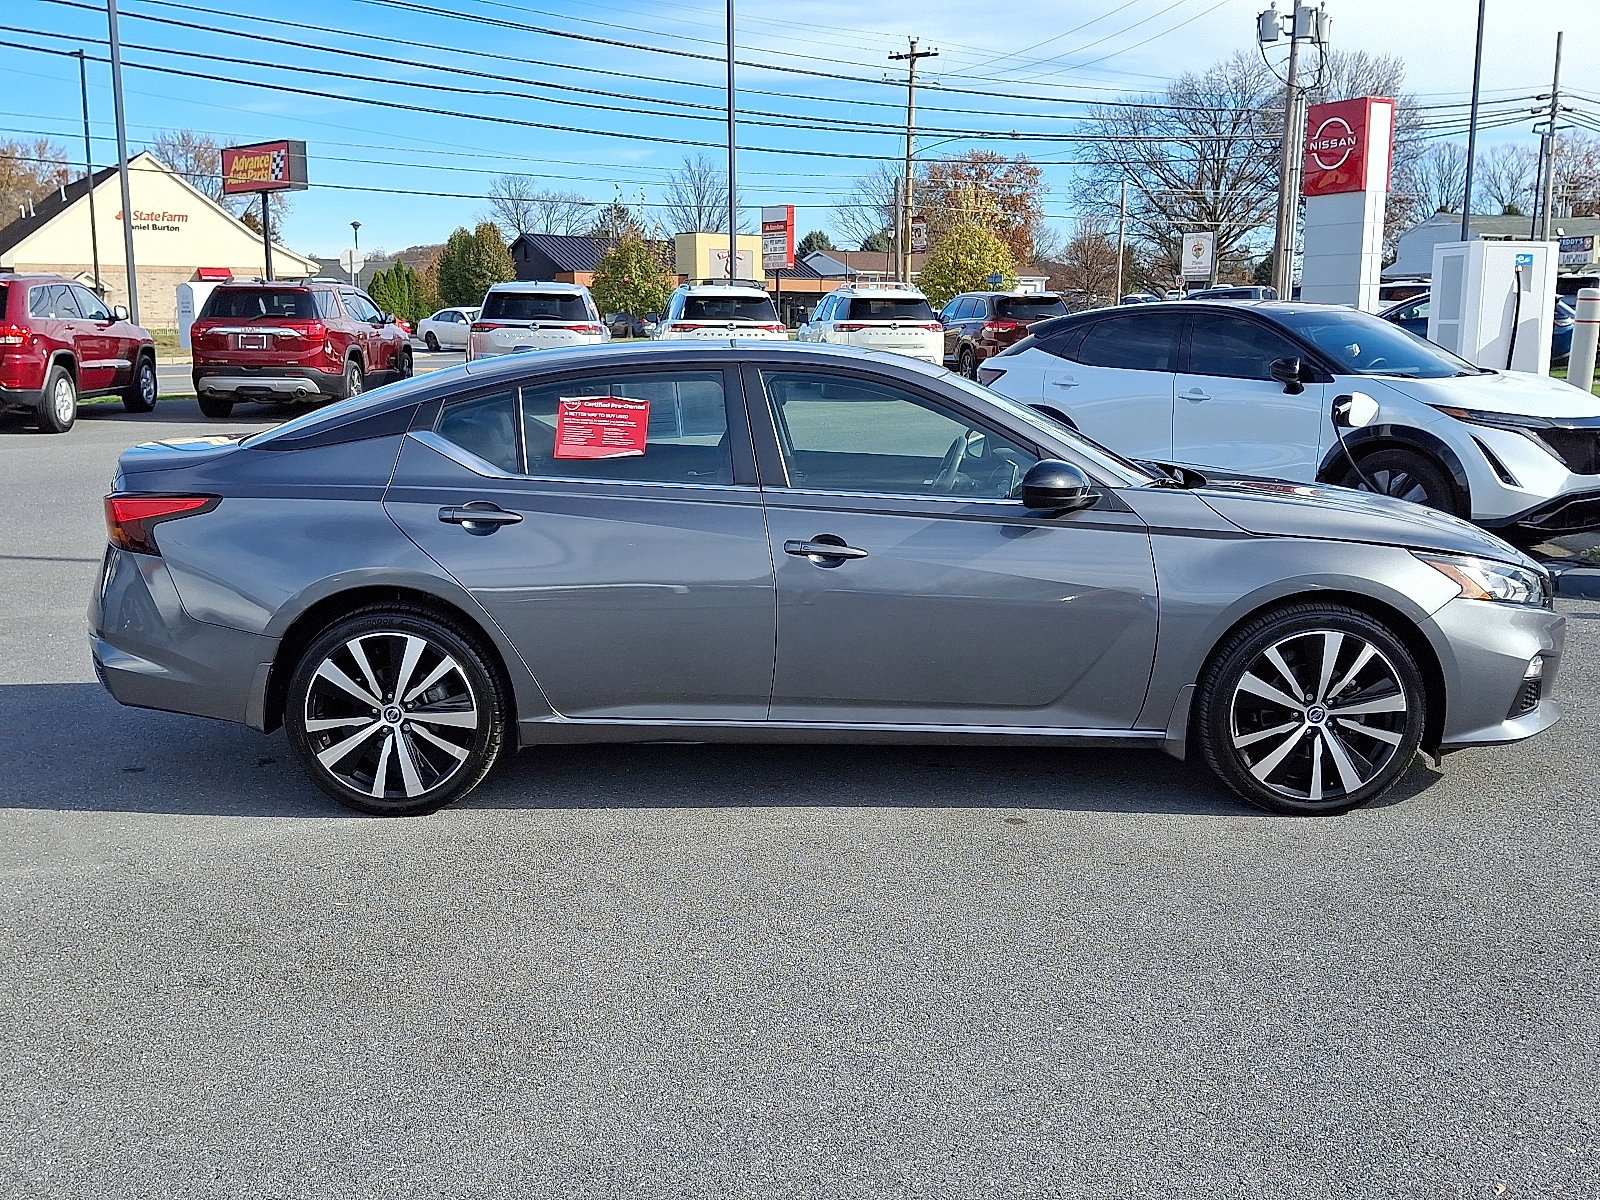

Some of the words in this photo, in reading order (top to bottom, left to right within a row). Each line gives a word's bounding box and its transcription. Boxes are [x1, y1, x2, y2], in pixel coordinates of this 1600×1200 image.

[1310, 136, 1357, 151] NISSAN
[230, 154, 270, 172] Advance
[226, 170, 247, 185] Auto
[246, 168, 269, 182] Parts
[151, 223, 180, 232] Burton
[610, 402, 646, 410] Pre-Owned
